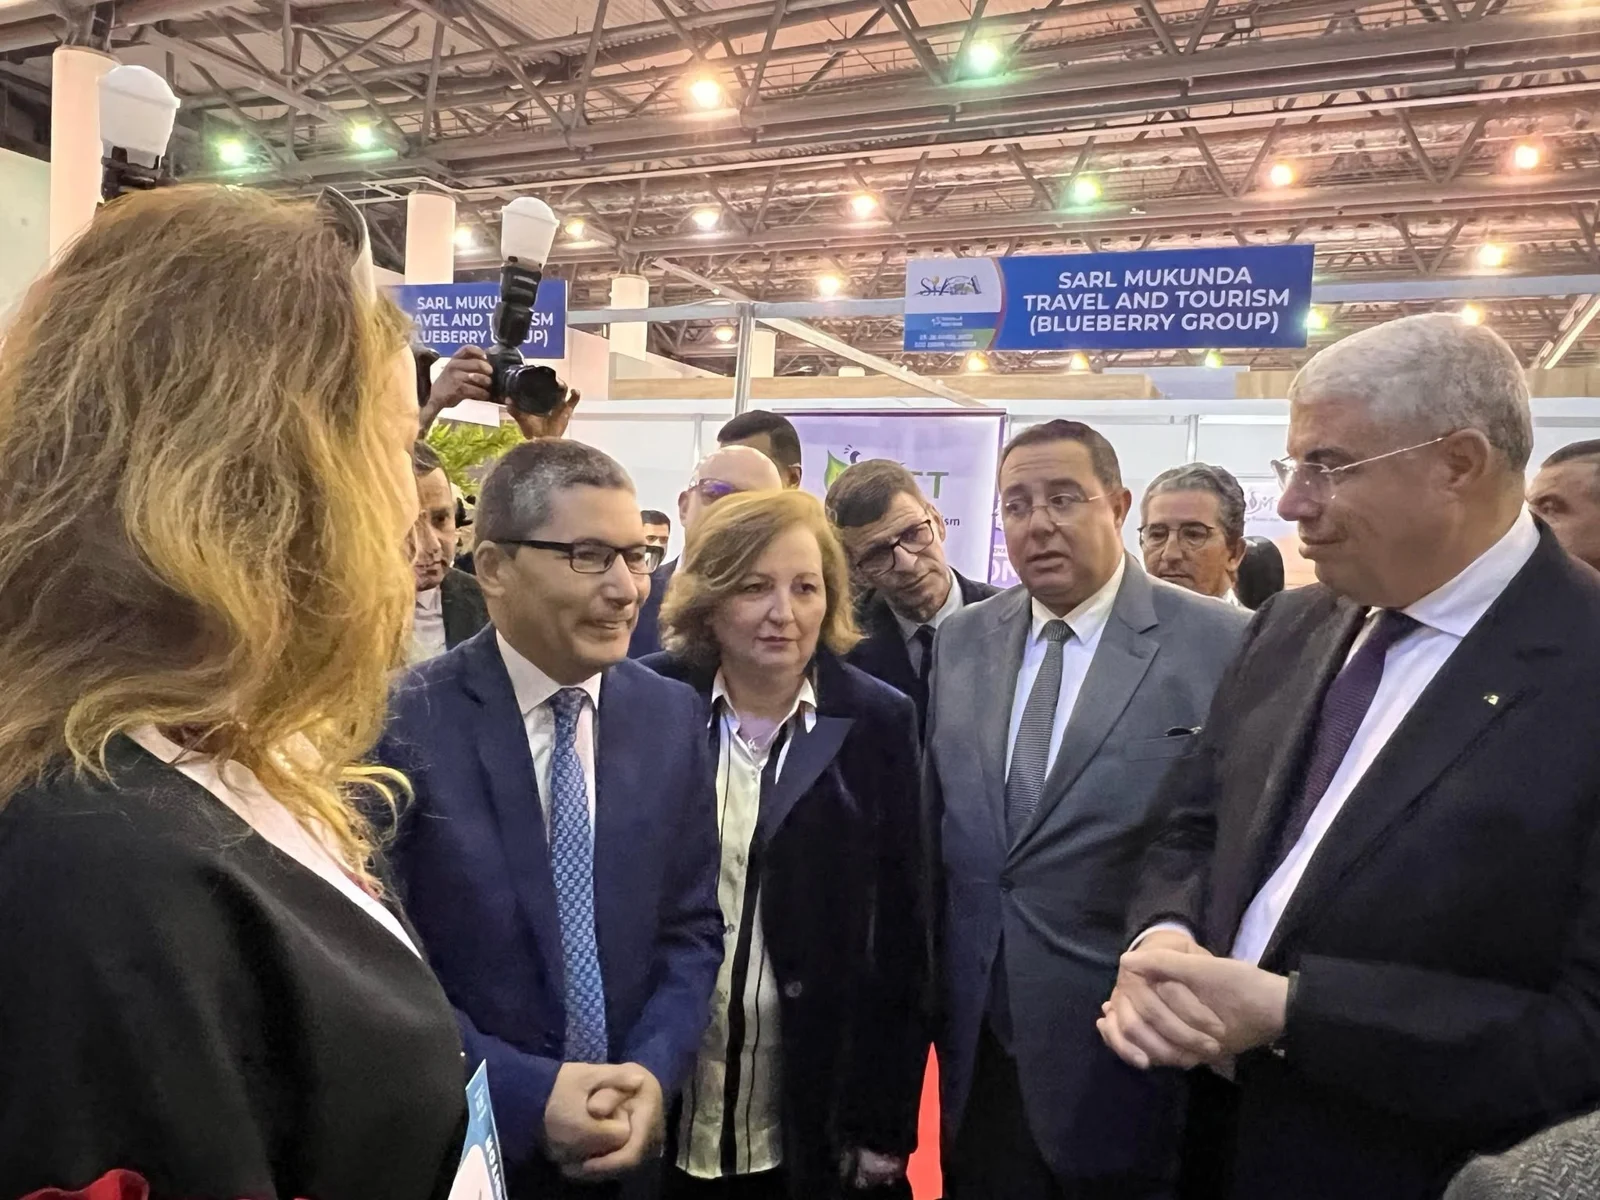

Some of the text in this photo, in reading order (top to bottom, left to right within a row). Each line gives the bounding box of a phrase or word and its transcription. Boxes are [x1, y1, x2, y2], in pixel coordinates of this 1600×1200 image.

[1058, 266, 1253, 289] SARL MUKUNDA
[416, 296, 453, 311] SARL
[1023, 288, 1290, 311] TRAVEL AND TOURISM
[451, 313, 484, 327] AND
[1029, 311, 1279, 337] (BLUEBERRY GROUP)
